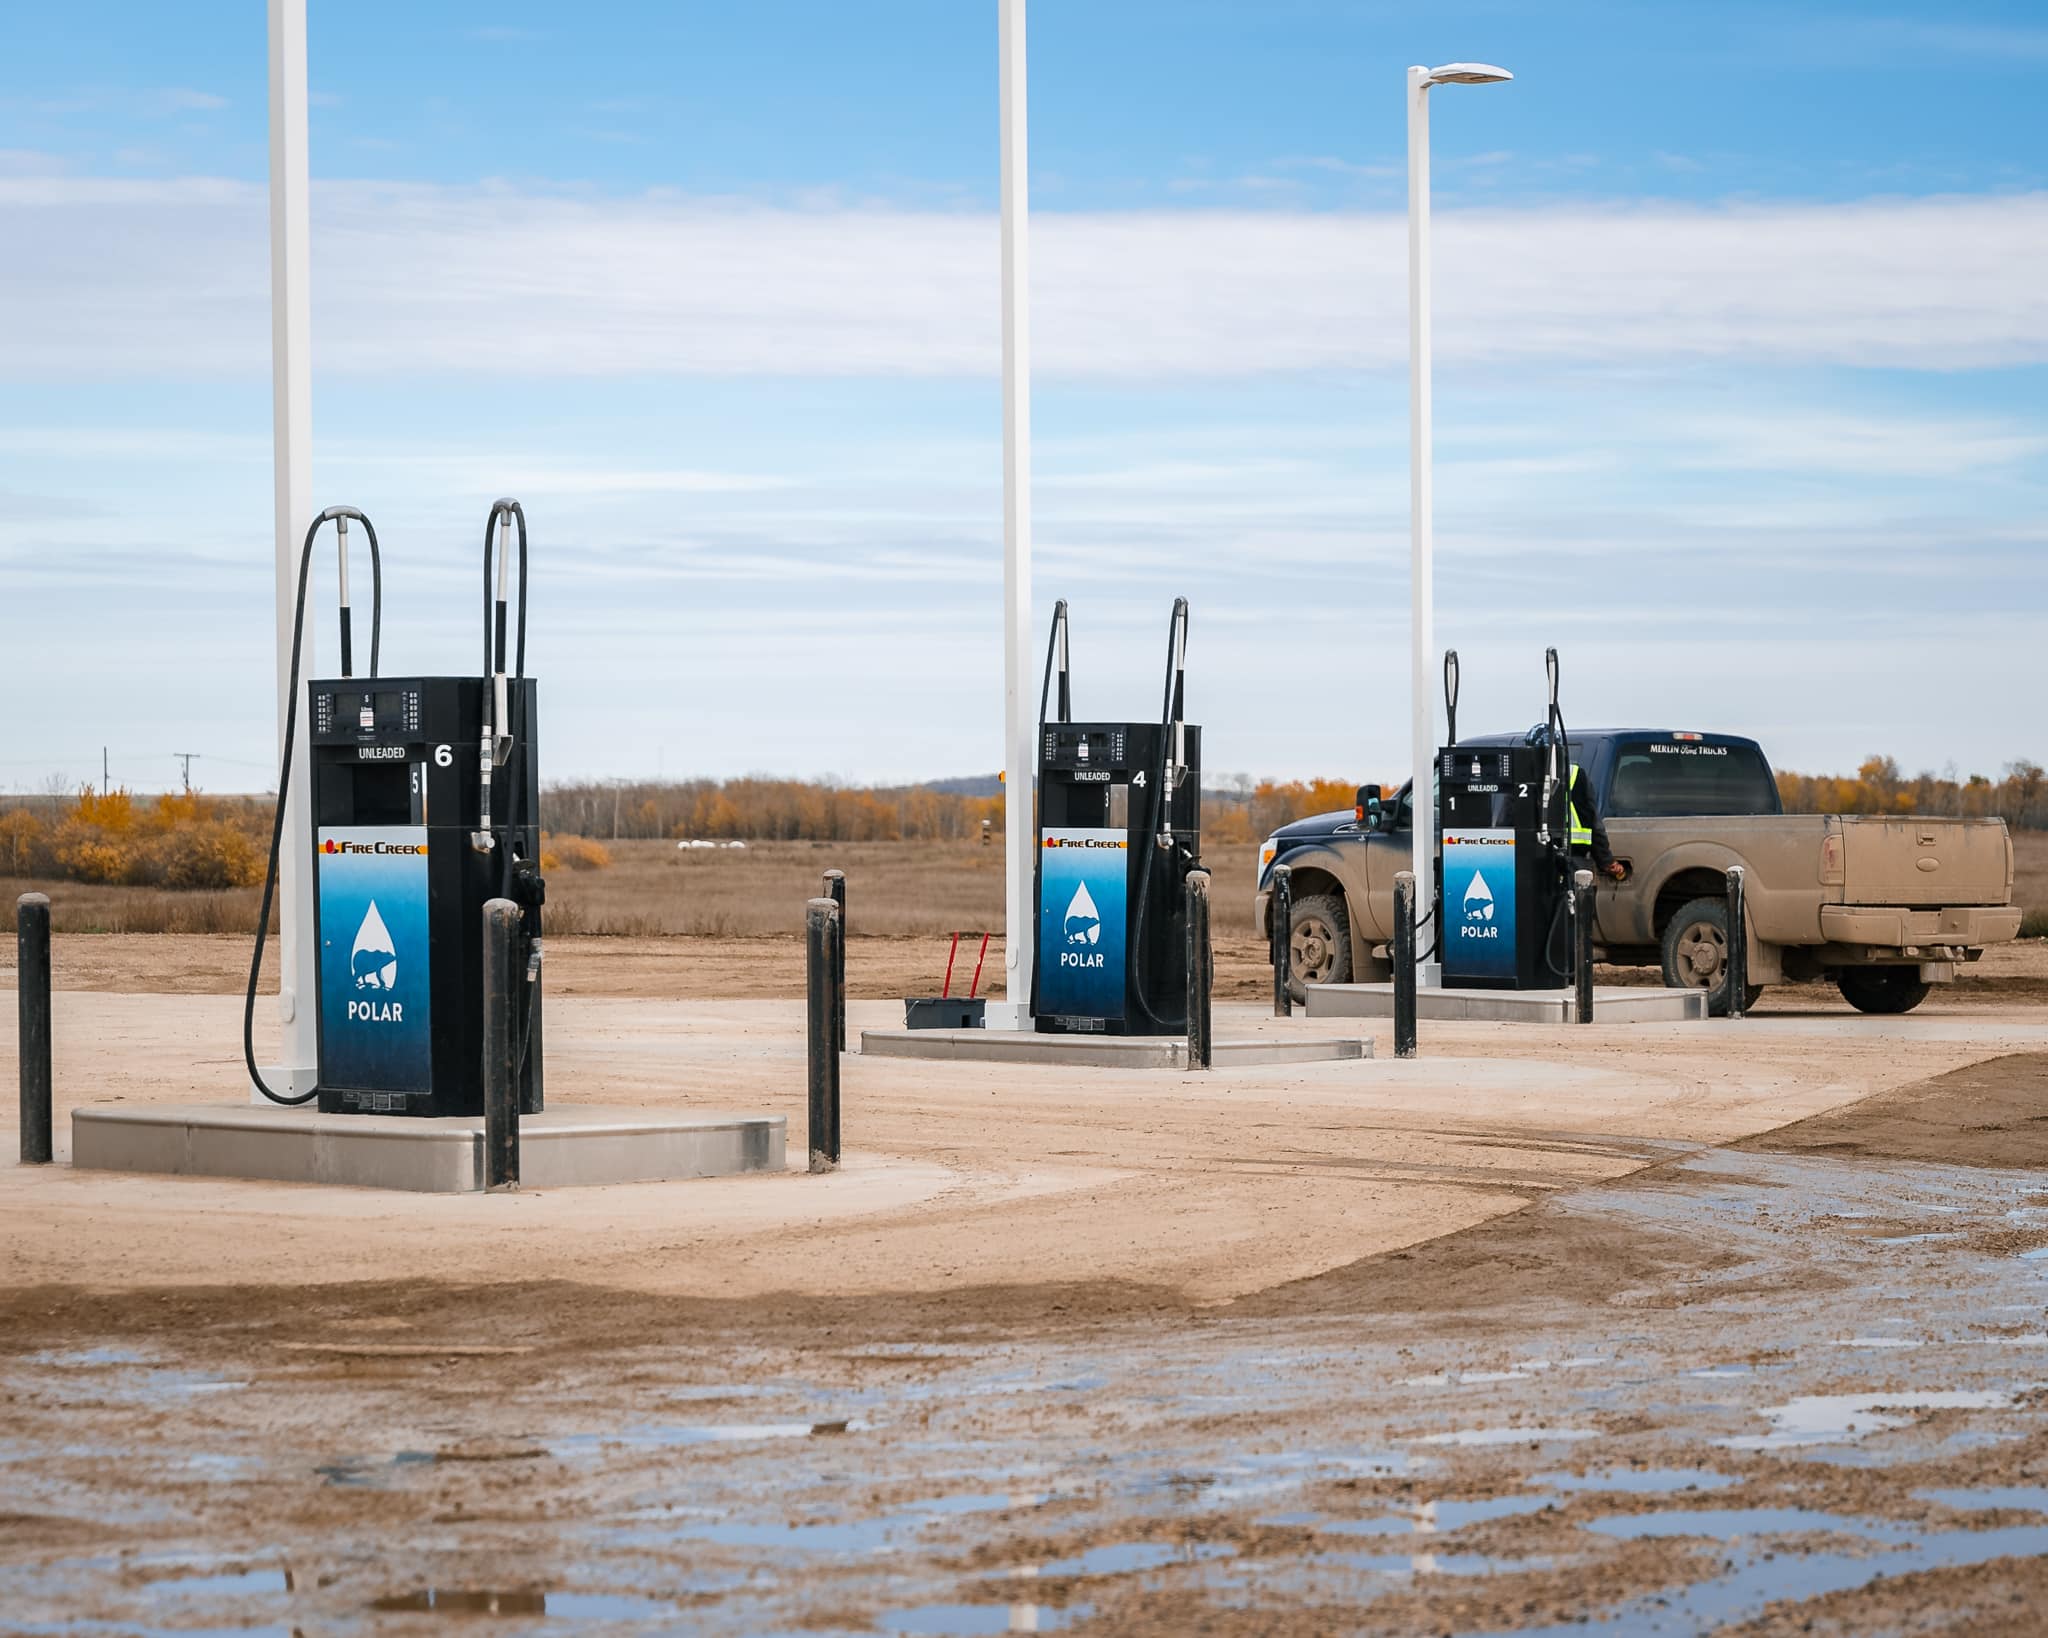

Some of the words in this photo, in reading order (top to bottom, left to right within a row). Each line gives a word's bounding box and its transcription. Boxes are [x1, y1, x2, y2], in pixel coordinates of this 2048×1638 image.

[358, 747, 405, 760] UNLEADED
[434, 744, 453, 767] 6
[1650, 744, 1679, 754] MERLIN
[1698, 746, 1728, 756] TRUCKS
[412, 772, 419, 794] 5
[1074, 771, 1111, 781] UNLEADED
[1132, 770, 1147, 788] 4
[1467, 784, 1498, 792] UNLEADED
[1518, 783, 1528, 798] 2
[1448, 796, 1456, 811] 1
[1461, 926, 1498, 938] POLAR
[1060, 952, 1104, 968] POLAR
[348, 1000, 403, 1022] POLAR
